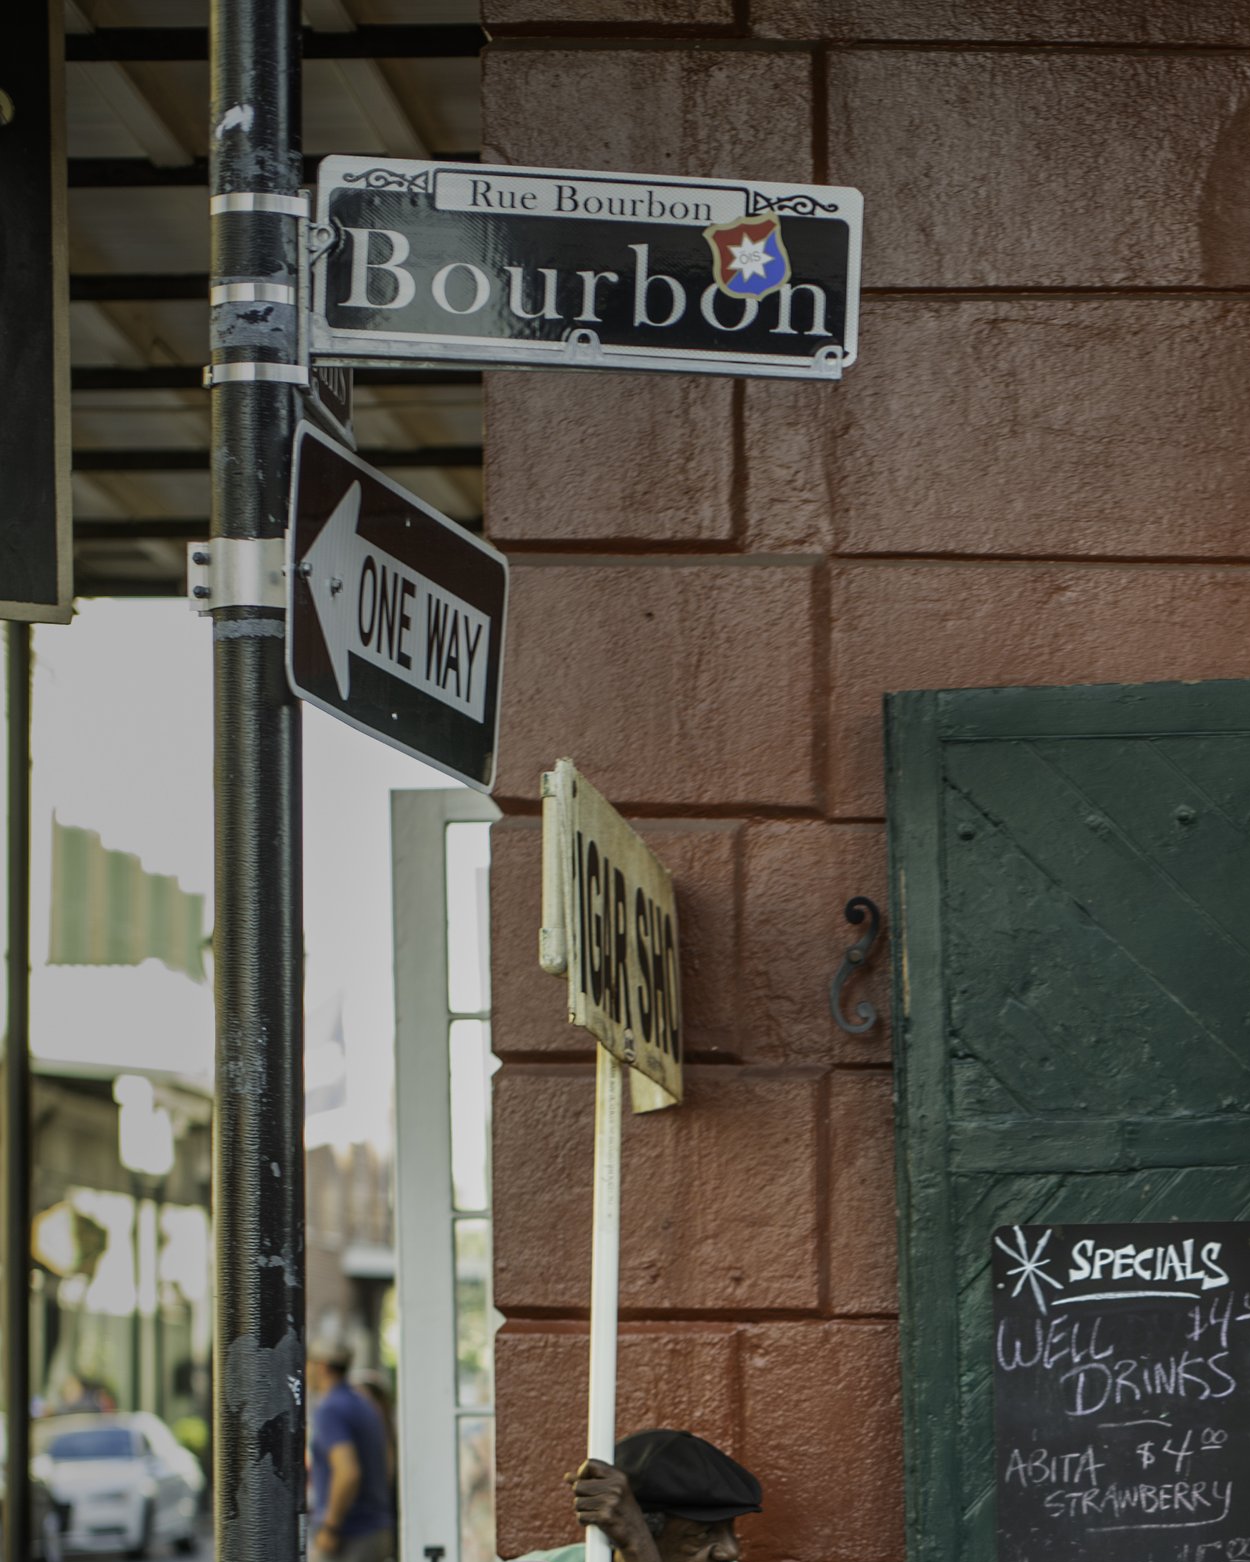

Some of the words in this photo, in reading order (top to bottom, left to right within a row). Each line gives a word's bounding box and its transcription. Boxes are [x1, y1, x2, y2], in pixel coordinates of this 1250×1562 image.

[467, 178, 538, 212] Rue
[553, 183, 714, 222] Bourbon
[337, 226, 834, 338] Bourbon
[356, 554, 416, 672] ONE
[426, 592, 484, 704] WAY
[572, 830, 632, 1030] IGAR
[1068, 1238, 1230, 1291] SPECIALS
[998, 1314, 1115, 1372] WELL
[1005, 1444, 1106, 1488] ABITA
[1043, 1480, 1233, 1520] STRAWBERRY
